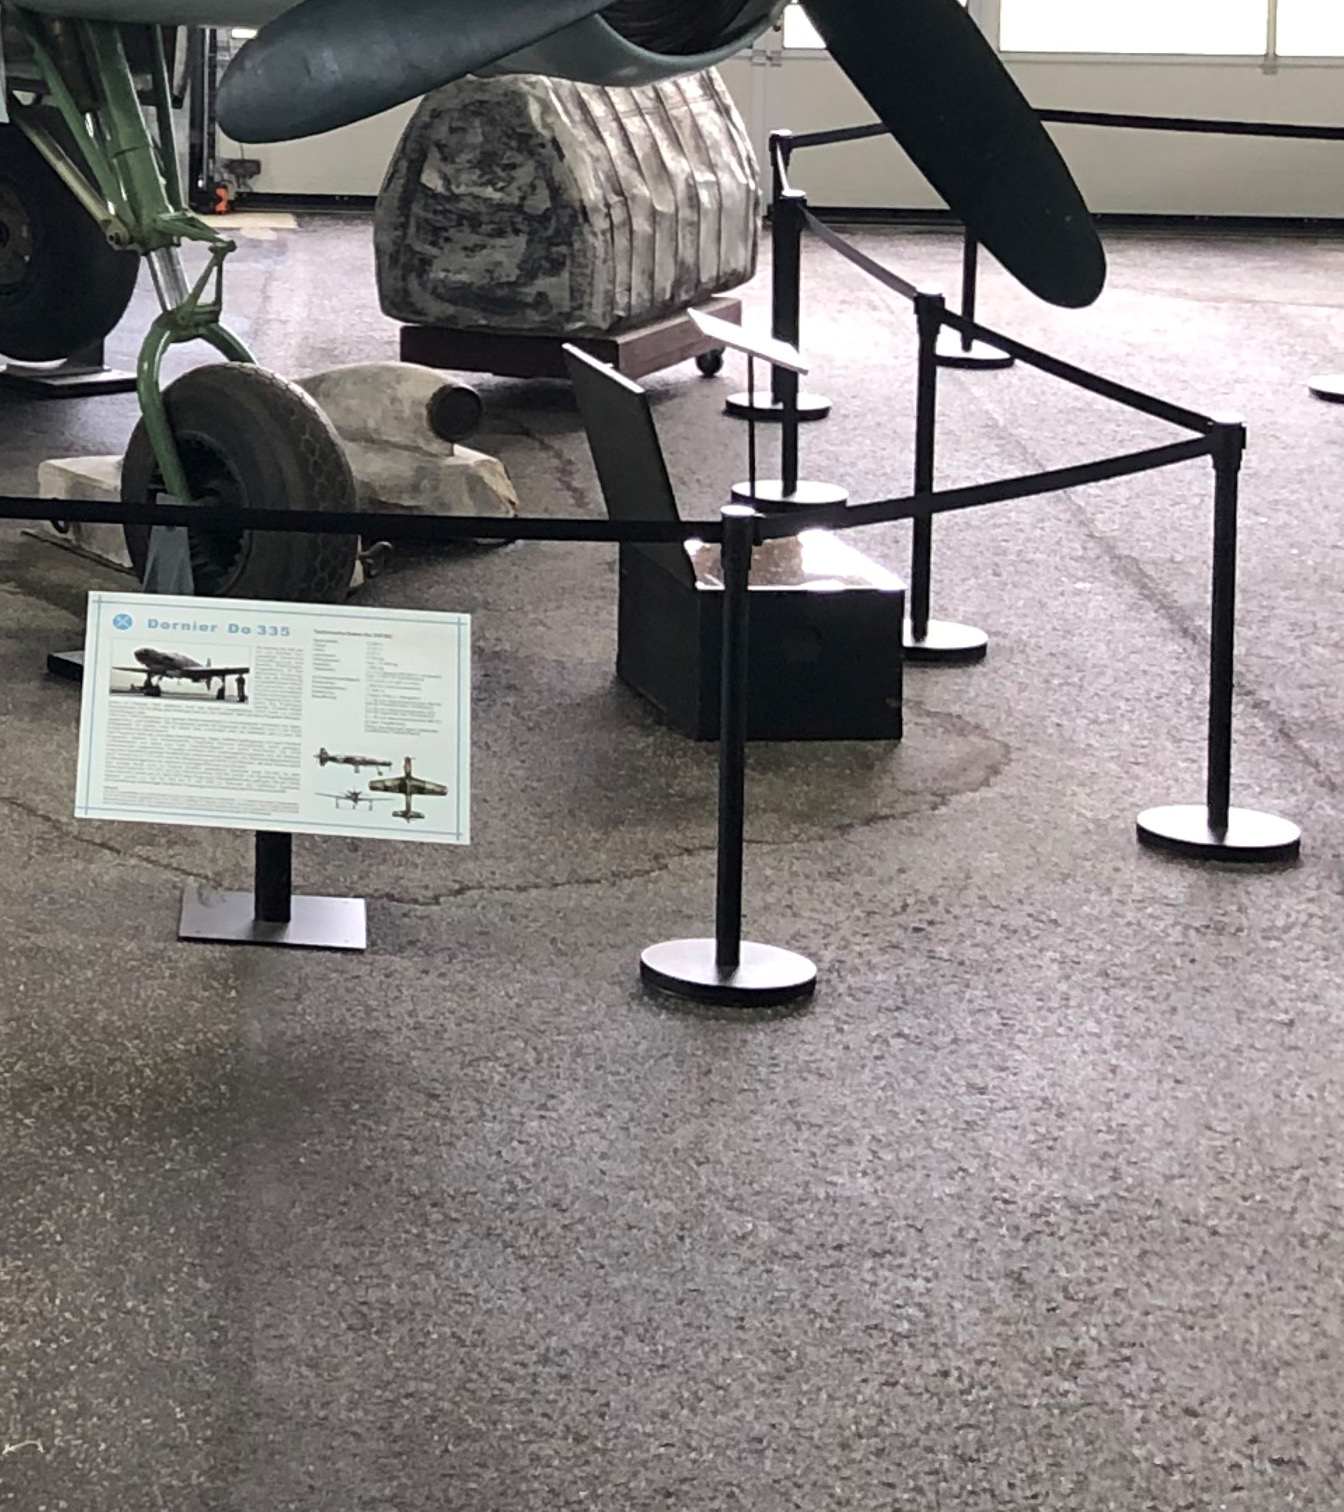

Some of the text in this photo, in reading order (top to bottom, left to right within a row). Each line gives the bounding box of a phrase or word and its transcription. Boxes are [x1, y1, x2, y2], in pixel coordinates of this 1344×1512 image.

[147, 618, 291, 637] Dornier Do 335
